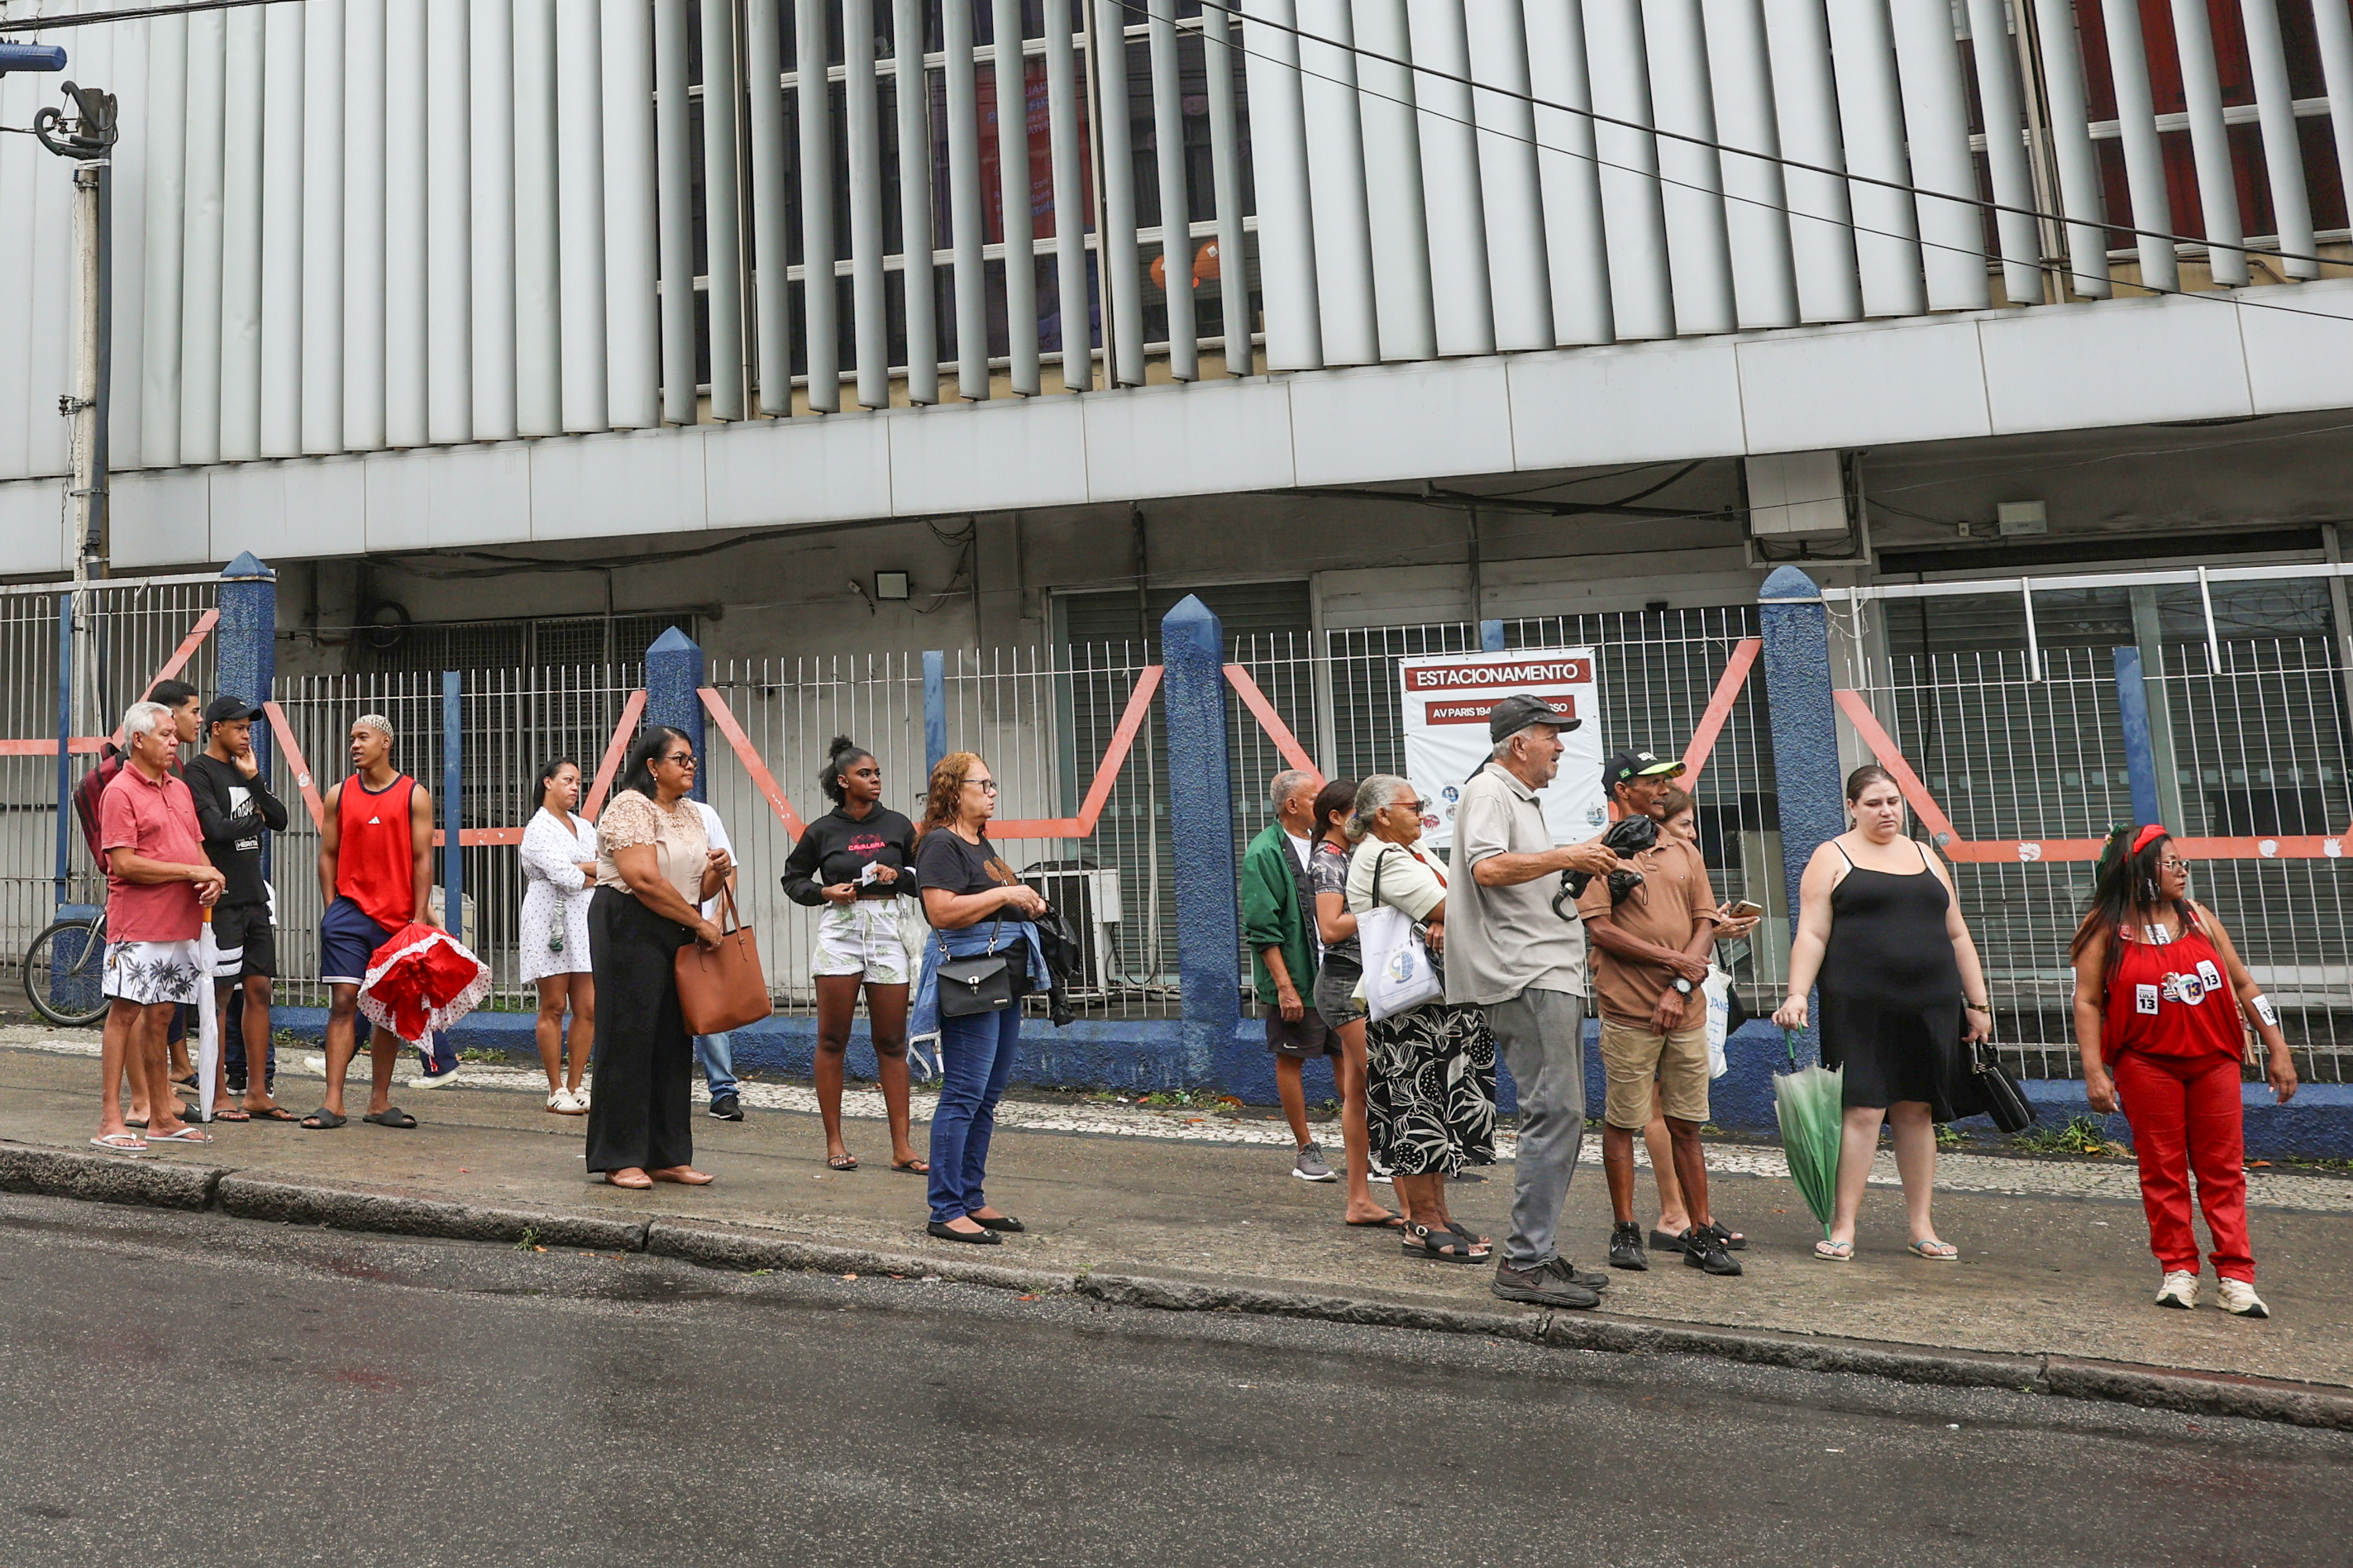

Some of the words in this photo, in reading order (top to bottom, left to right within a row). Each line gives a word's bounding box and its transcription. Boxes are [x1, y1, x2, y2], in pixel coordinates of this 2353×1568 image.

[1416, 664, 1578, 686] ESTACIONAMENTO
[1433, 708, 1447, 718] AV
[1449, 707, 1476, 717] PARIS
[847, 841, 885, 851] CAVALERA
[2204, 975, 2218, 986] 13
[2185, 982, 2202, 997] 13
[2139, 999, 2155, 1009] 13
